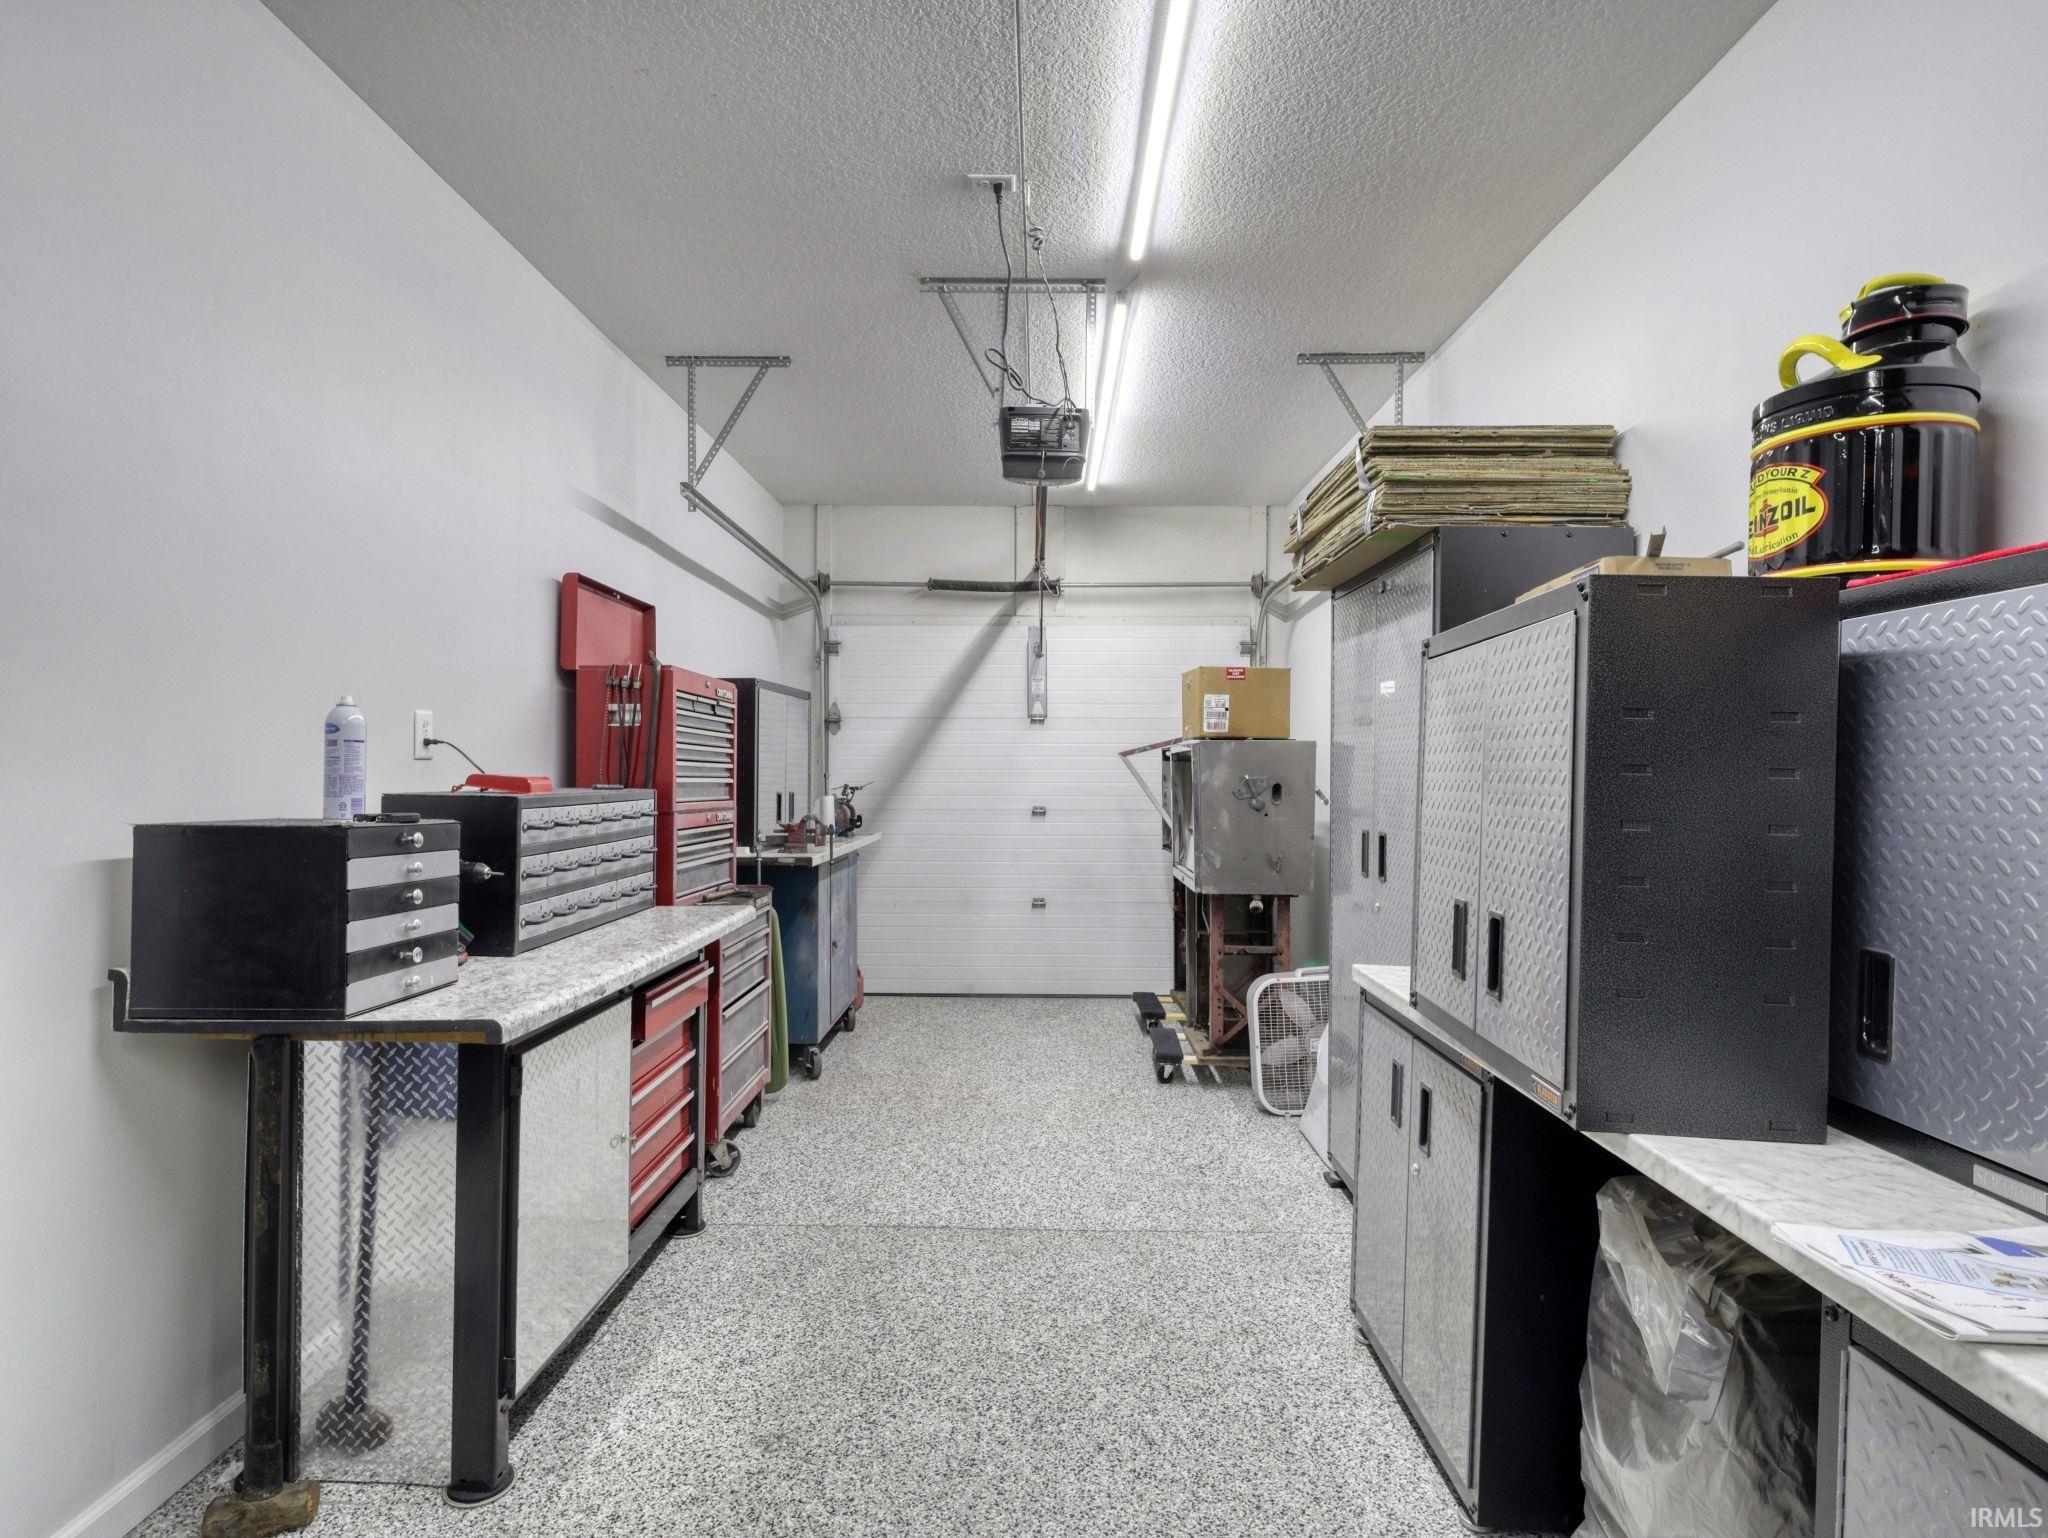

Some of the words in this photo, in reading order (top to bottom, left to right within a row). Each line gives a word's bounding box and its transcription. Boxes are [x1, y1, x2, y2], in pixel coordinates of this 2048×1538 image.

[1765, 467, 1798, 479] YOUR
[1800, 469, 1811, 479] Z
[1755, 532, 1799, 554] Lurication
